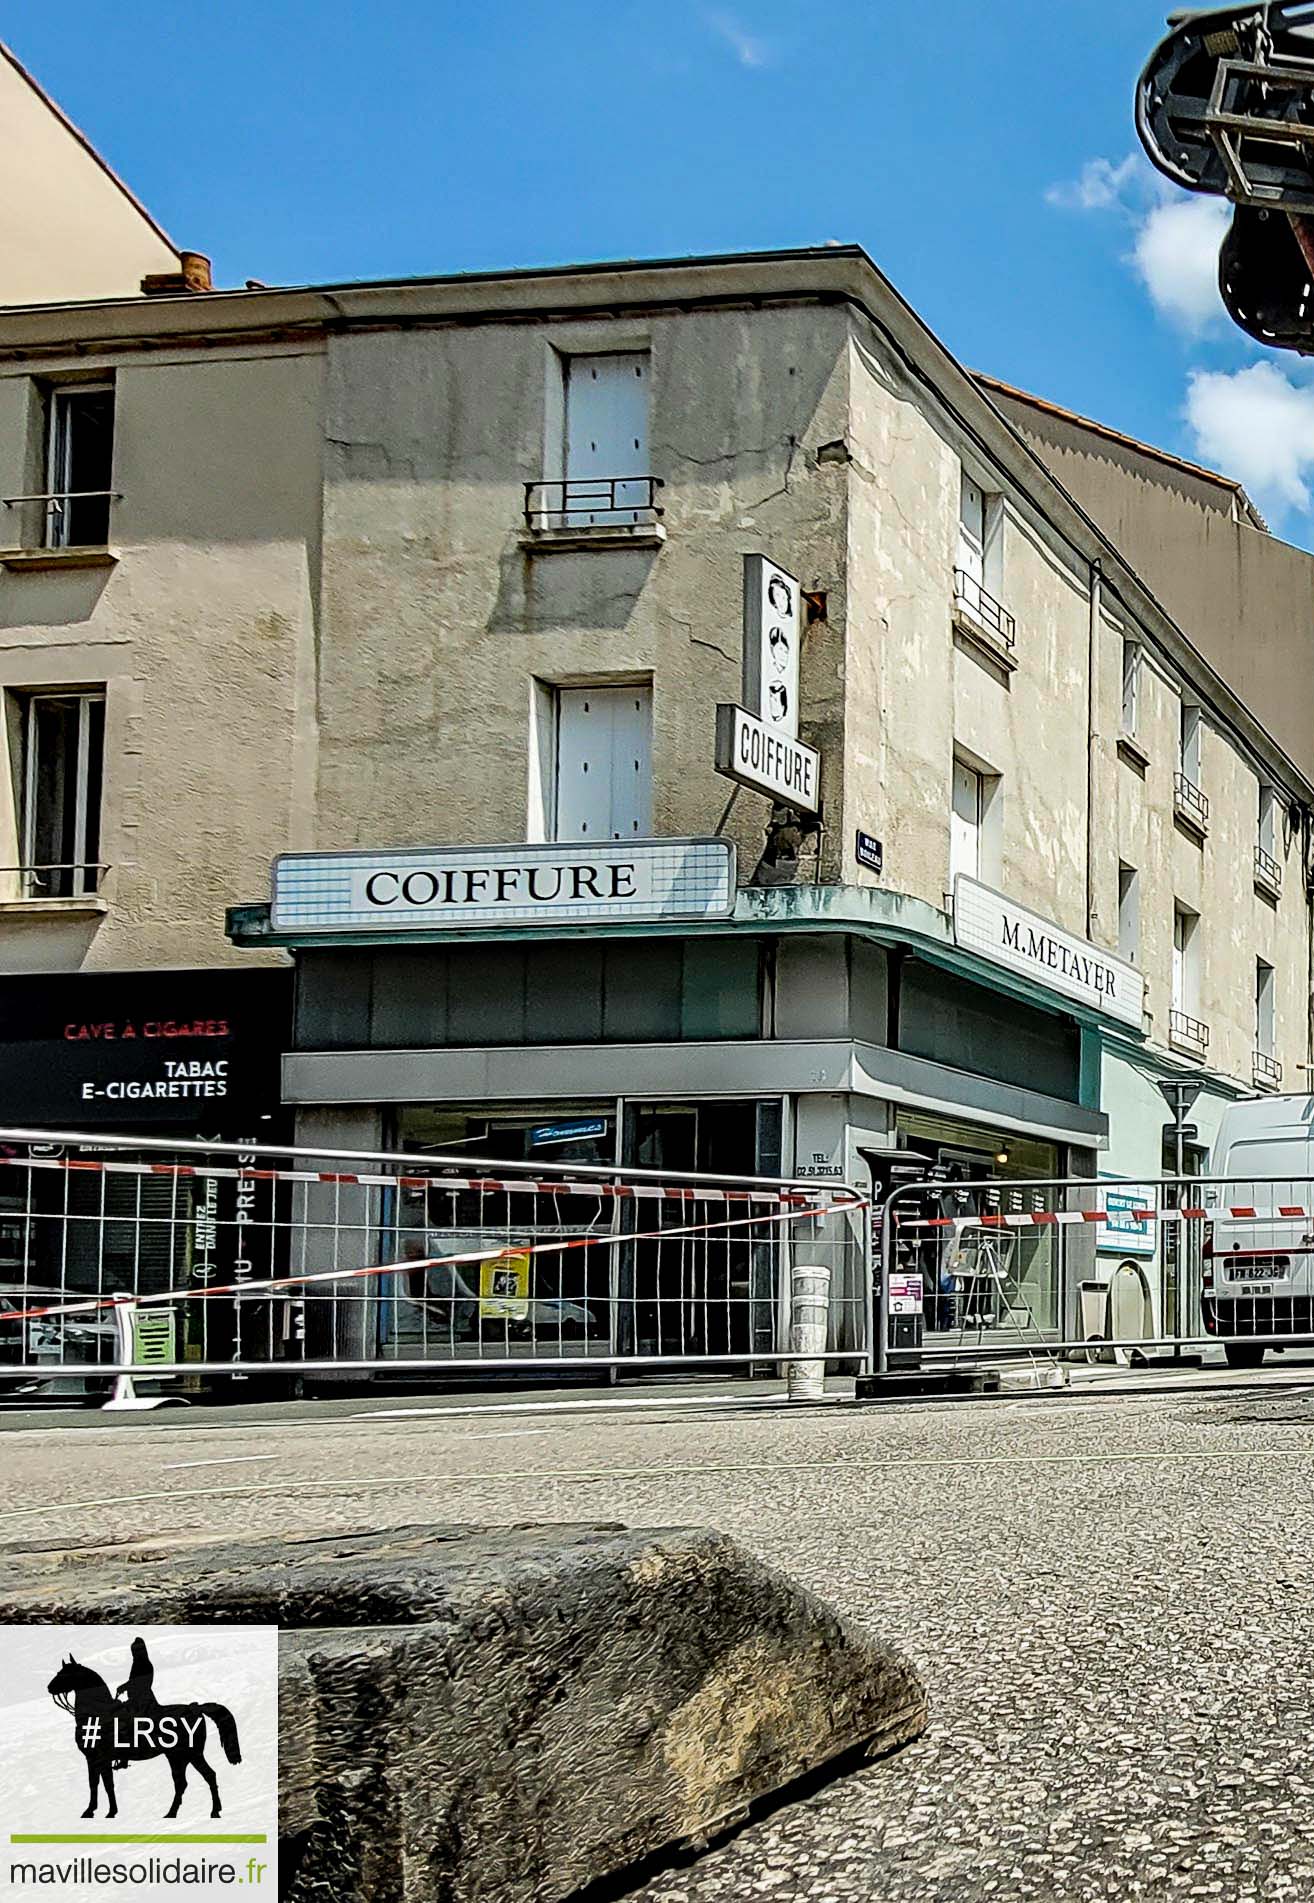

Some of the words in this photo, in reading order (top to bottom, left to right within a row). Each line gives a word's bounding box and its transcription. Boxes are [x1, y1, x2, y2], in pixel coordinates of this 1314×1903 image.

[741, 722, 812, 797] COIFFURE
[365, 863, 638, 906] COIFFURE
[1001, 913, 1117, 998] M.METAYER
[64, 1023, 116, 1040] CAVE
[143, 1020, 230, 1038] CIGARES
[164, 1060, 229, 1078] TABAC
[82, 1080, 228, 1100] E-CIGARETTES
